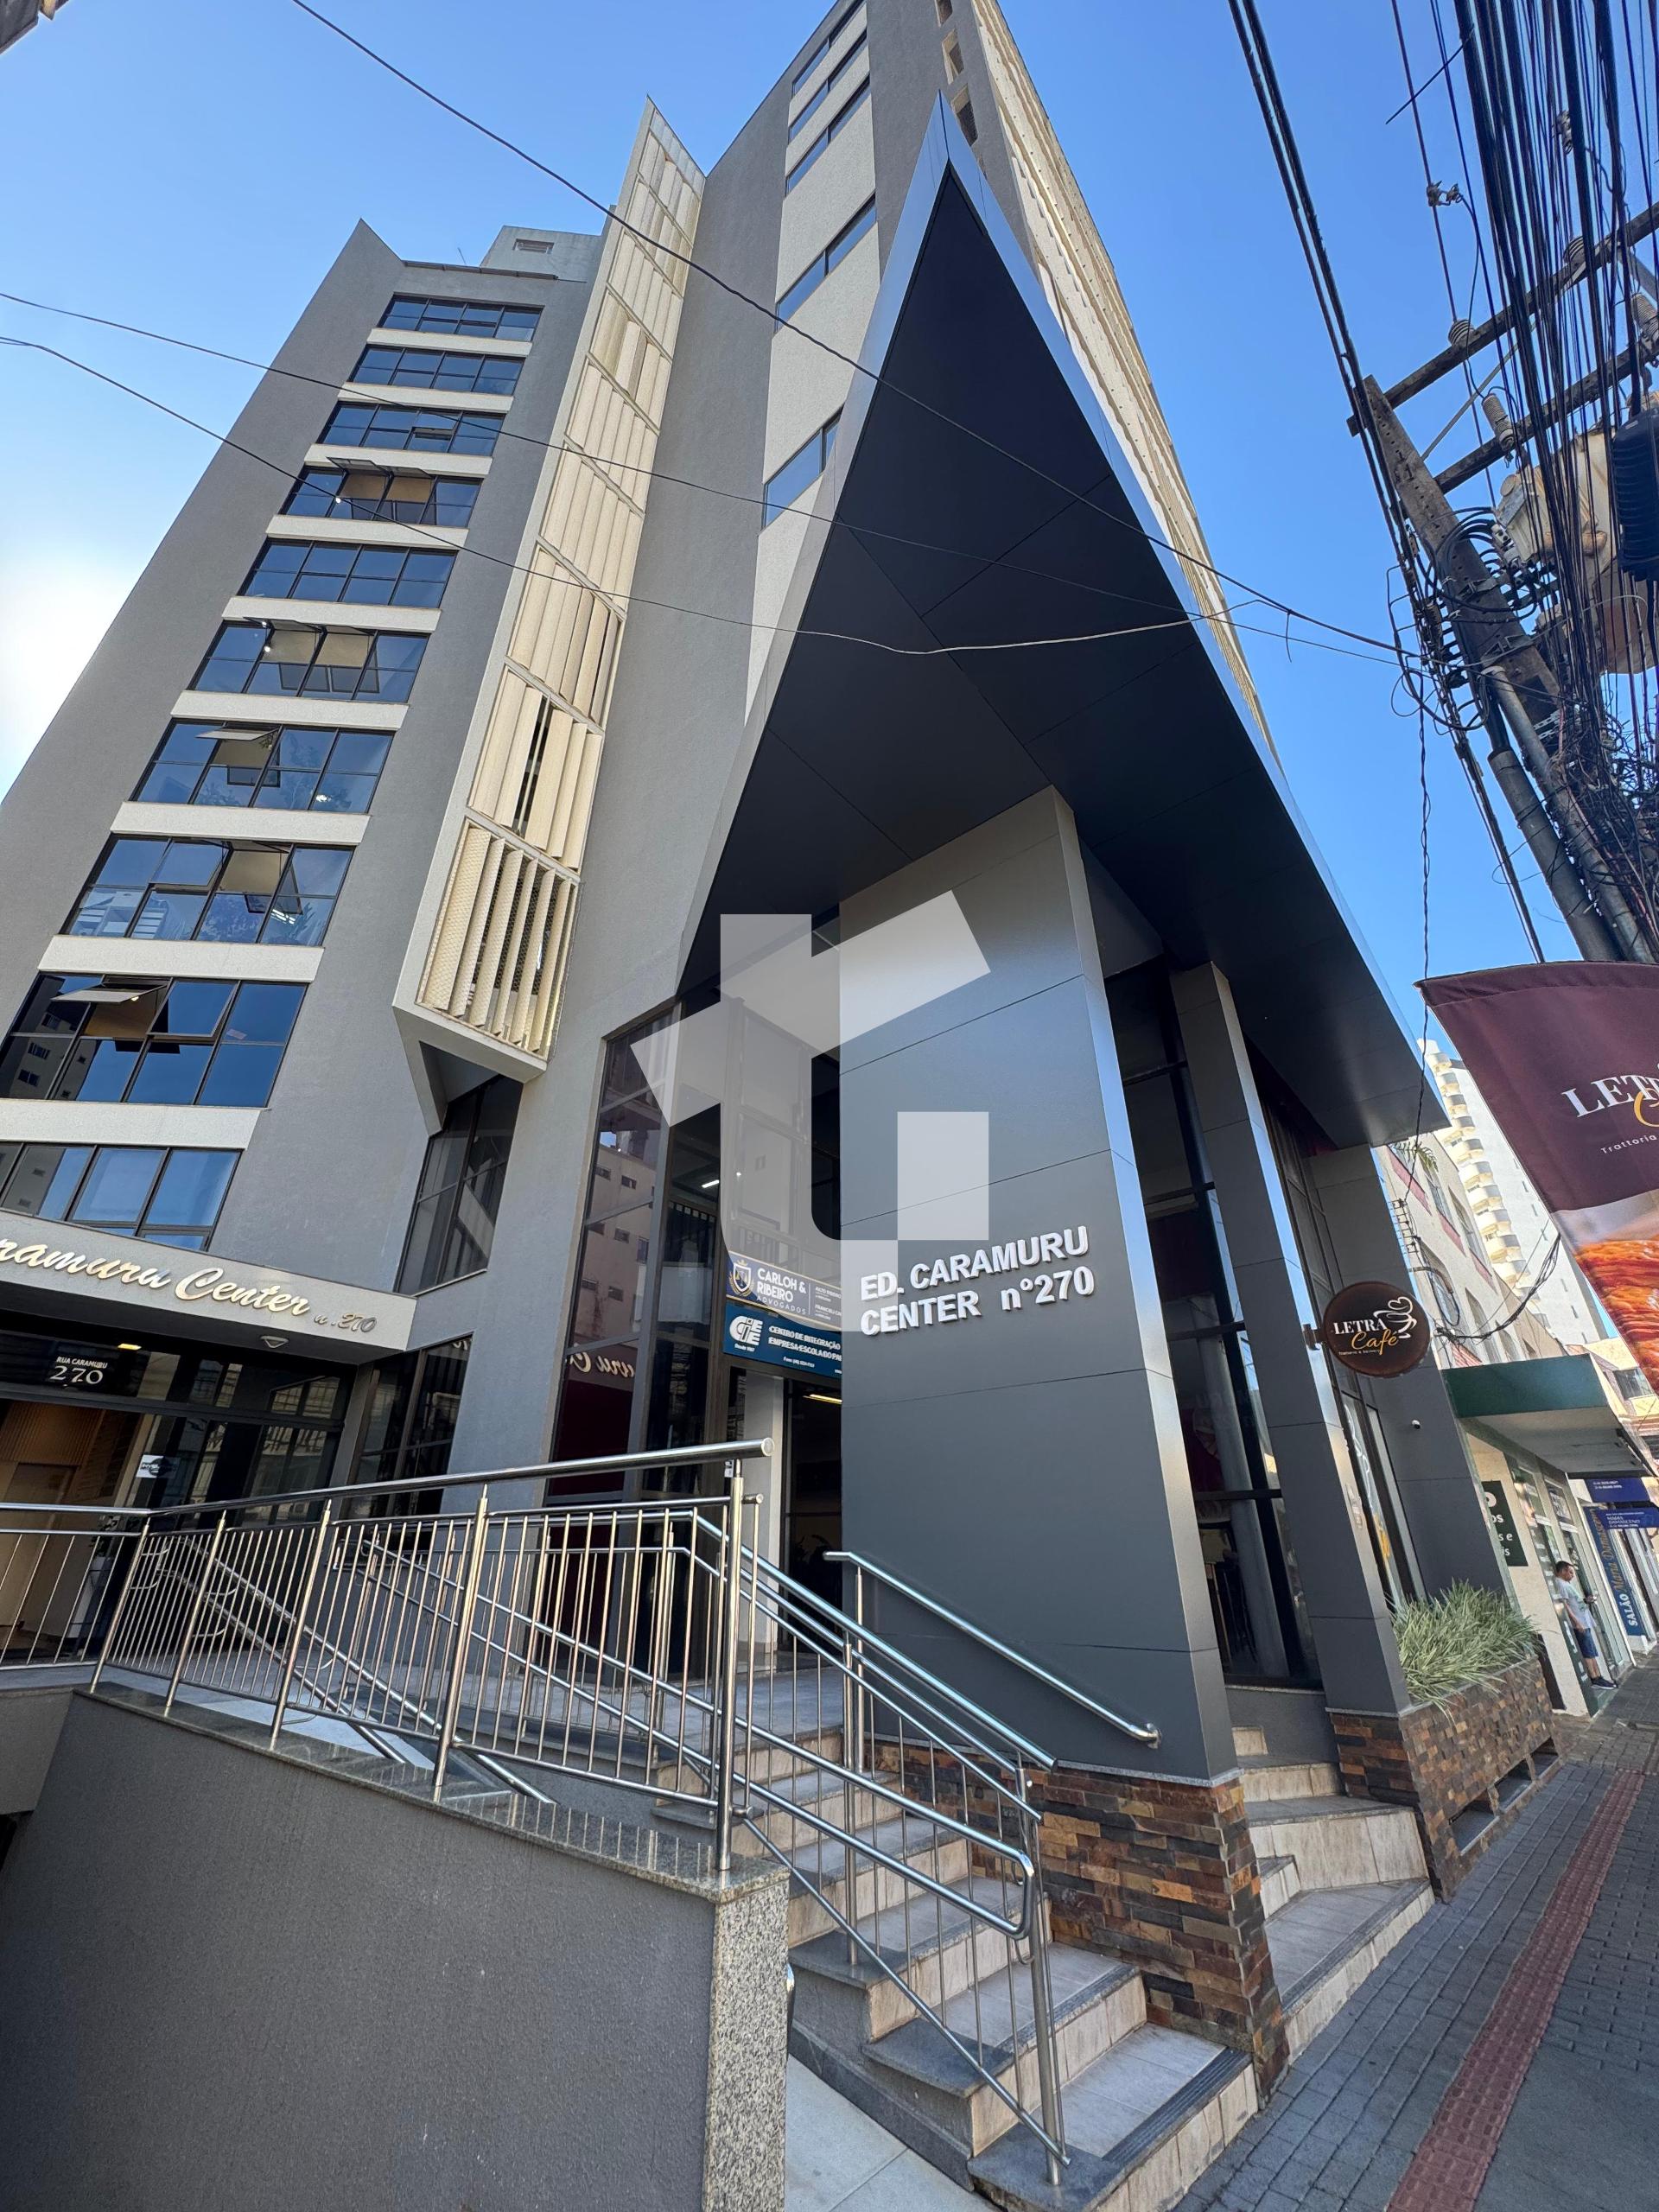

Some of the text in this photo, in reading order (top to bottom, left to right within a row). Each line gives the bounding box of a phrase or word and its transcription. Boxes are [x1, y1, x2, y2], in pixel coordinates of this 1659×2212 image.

[1600, 1135, 1657, 1154] Trattoria
[861, 1225, 1090, 1301] ED. CARAMURU
[175, 1267, 311, 1317] Center
[757, 1281, 794, 1303] RIBEIRO
[758, 1268, 798, 1291] CARLOH
[798, 1281, 807, 1294] &
[756, 1295, 806, 1315] ADVOGADOS
[861, 1290, 982, 1336] CENTER
[768, 1325, 795, 1338] CENTRO
[1333, 1318, 1389, 1335] LETRA
[1351, 1328, 1398, 1356] Café
[56, 1356, 108, 1370] RUA CARAMURU
[50, 1365, 104, 1385] 270
[1619, 1593, 1638, 1626] SALÃO
